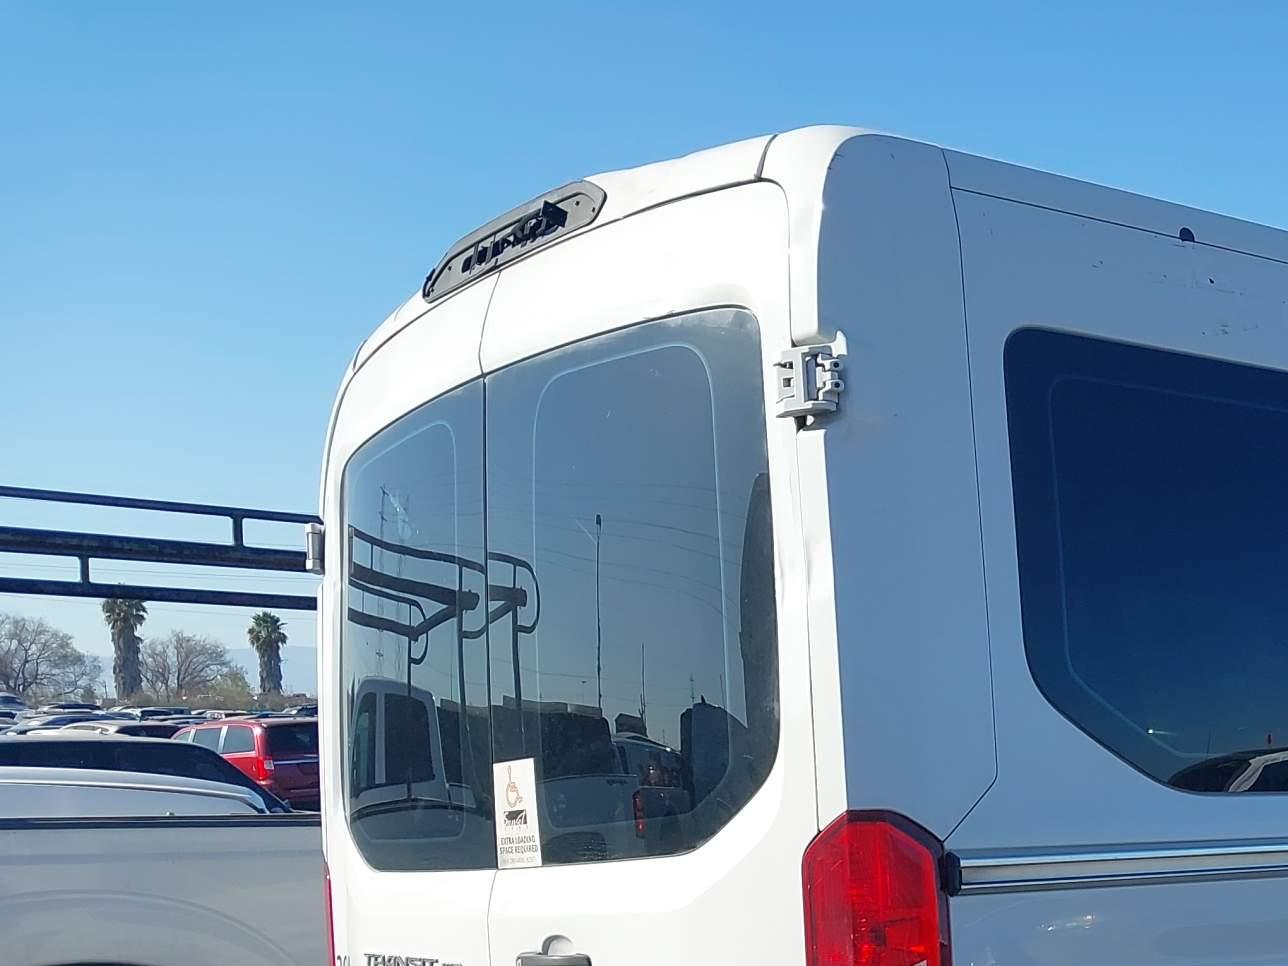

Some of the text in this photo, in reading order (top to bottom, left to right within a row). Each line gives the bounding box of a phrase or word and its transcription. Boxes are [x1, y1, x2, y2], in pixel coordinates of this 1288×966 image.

[500, 834, 536, 846] EXTRA LOADING
[499, 843, 539, 855] SPACE REQUIRED
